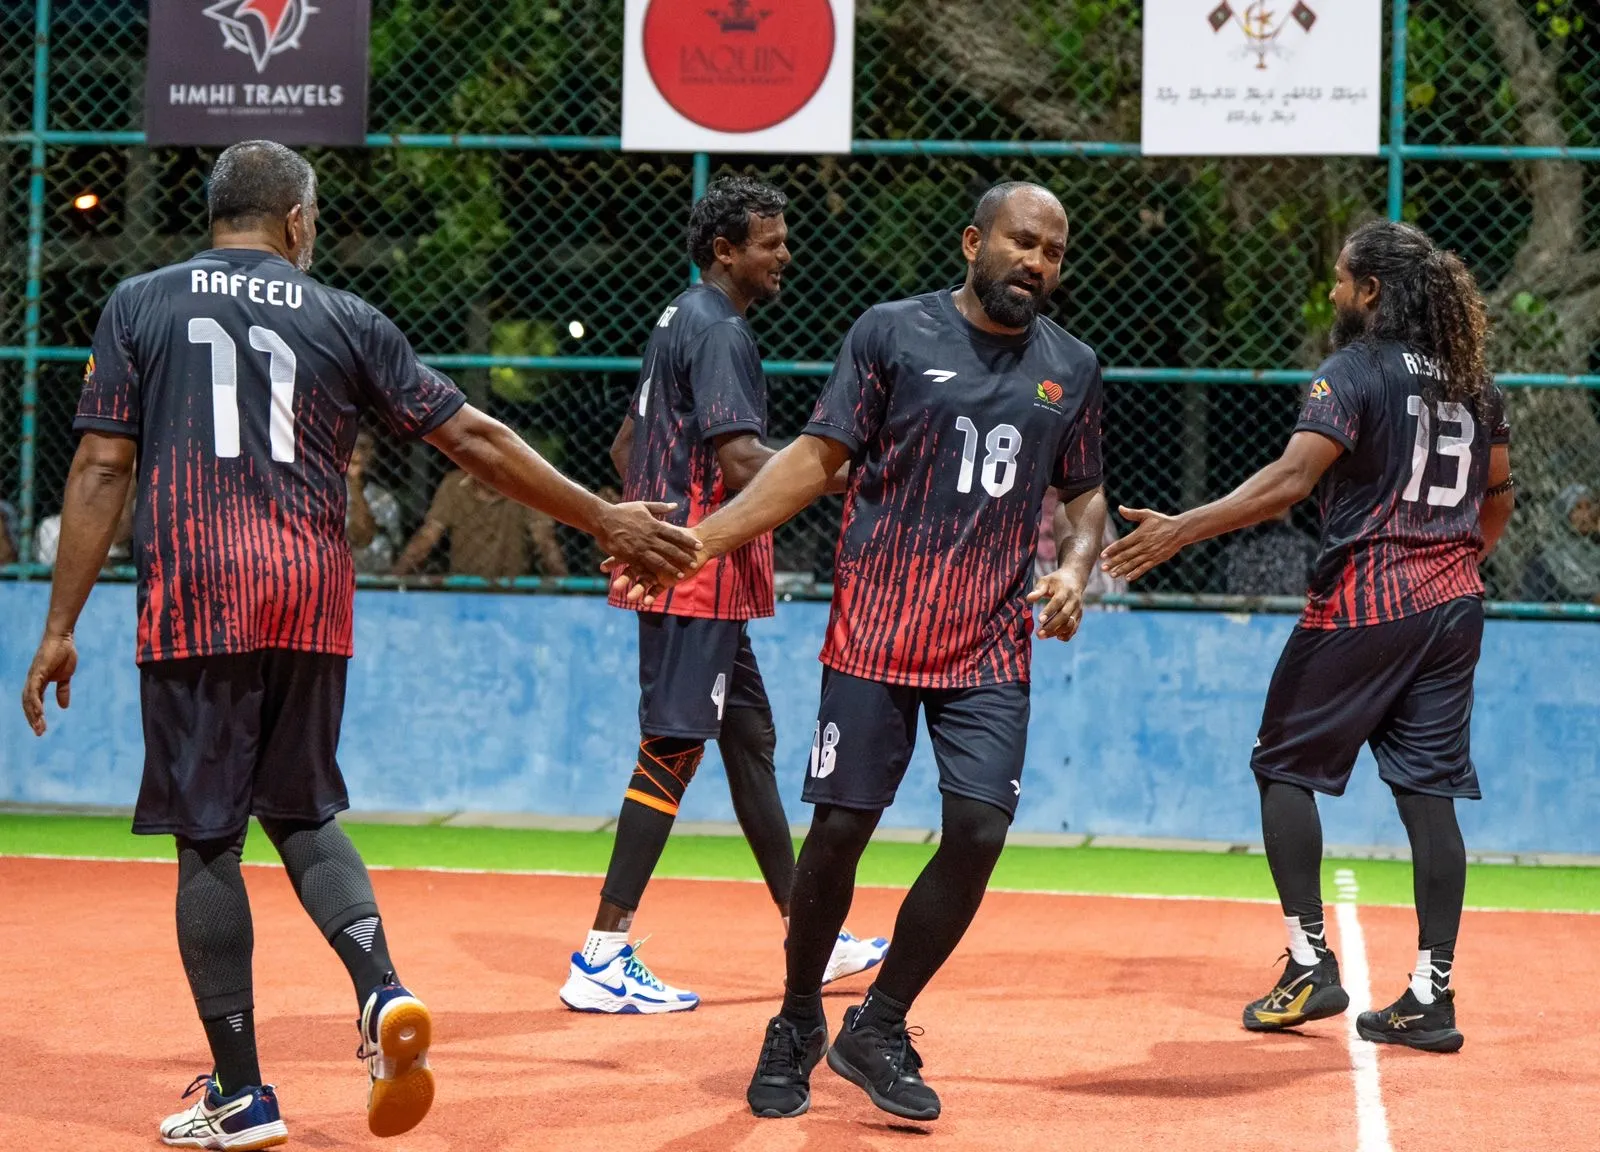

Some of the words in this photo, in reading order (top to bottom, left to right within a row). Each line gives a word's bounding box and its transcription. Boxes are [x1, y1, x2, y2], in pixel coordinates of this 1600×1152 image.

[169, 84, 236, 106] HMHI
[242, 84, 344, 107] TRAVELS
[191, 269, 303, 309] RAFEEU
[187, 317, 298, 464] 11
[955, 415, 1023, 498] 18
[1402, 395, 1475, 506] 13
[711, 673, 726, 721] 4
[811, 720, 840, 779] 18
